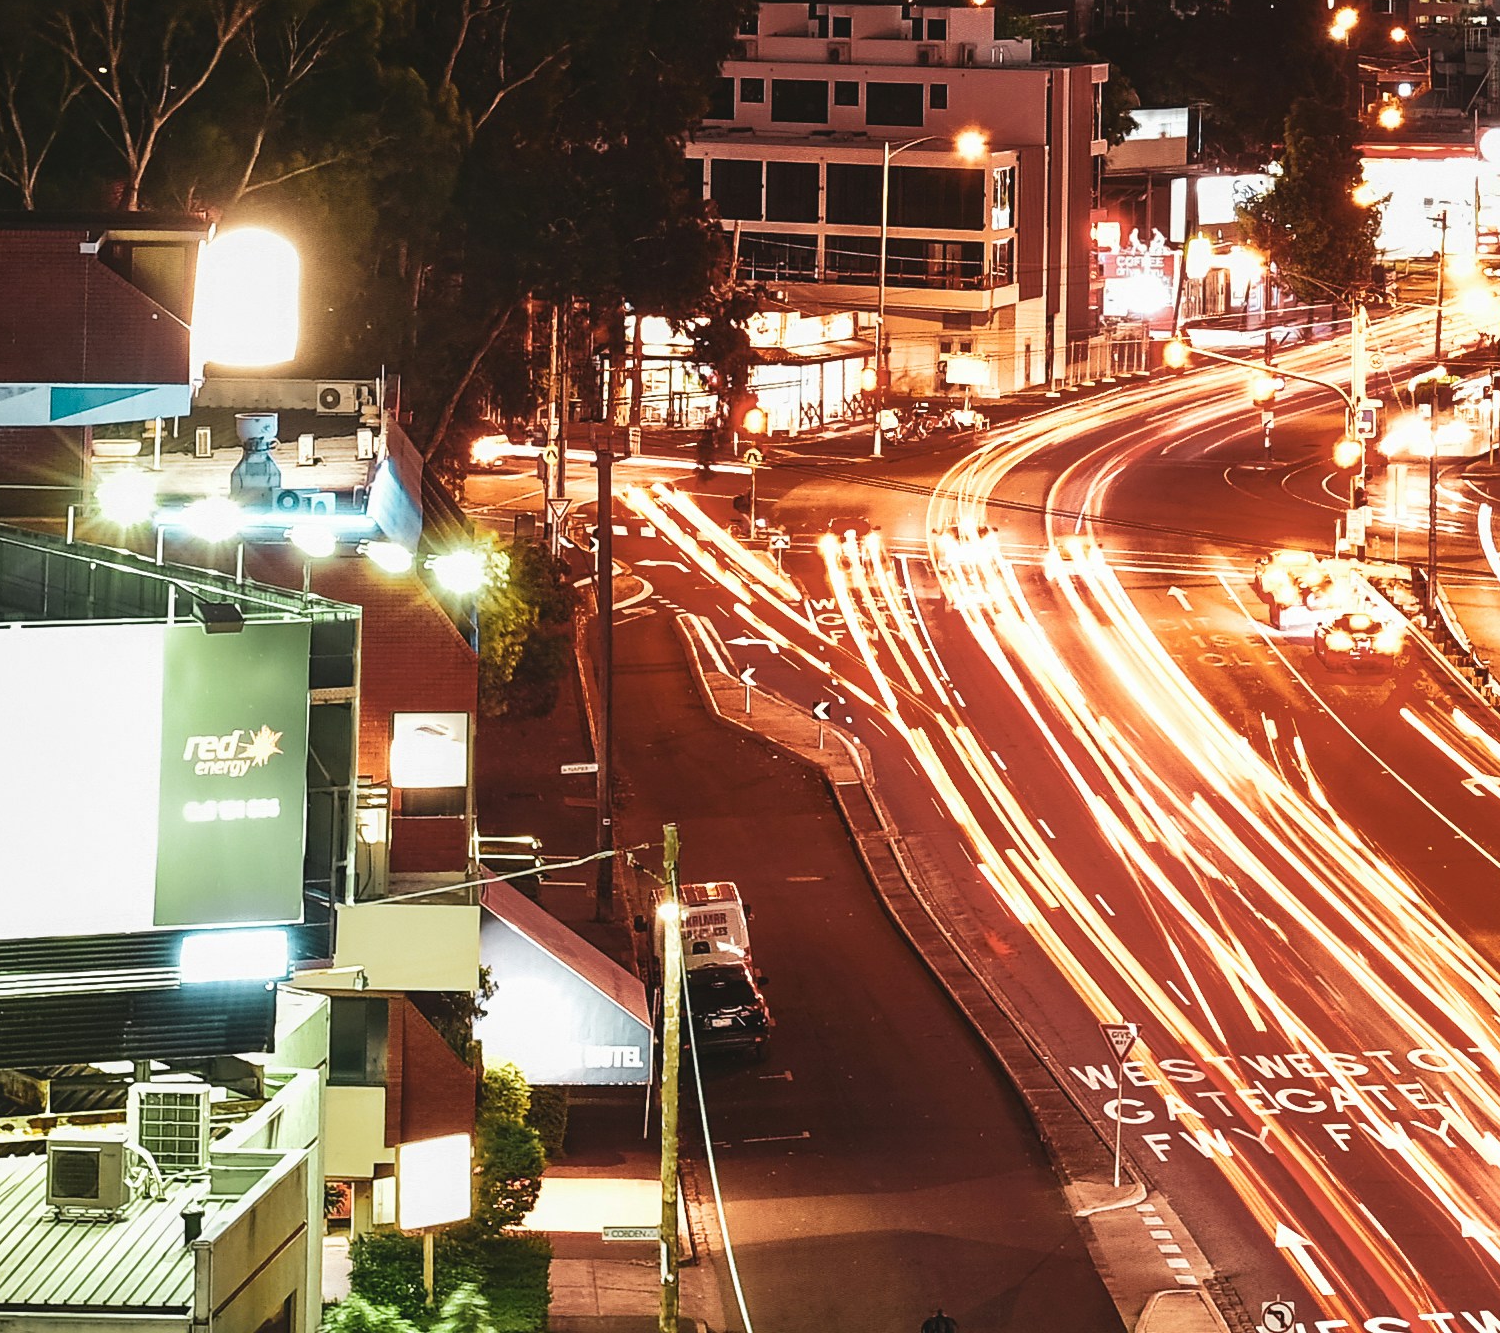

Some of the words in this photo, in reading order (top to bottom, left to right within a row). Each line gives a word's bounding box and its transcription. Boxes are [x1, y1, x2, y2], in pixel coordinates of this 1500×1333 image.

[183, 729, 245, 761] red
[194, 760, 251, 778] energy
[1240, 1049, 1402, 1079] WEST
[1103, 1087, 1281, 1125] GATE
[1274, 1083, 1448, 1114] GATE
[1141, 1126, 1275, 1162] FWY
